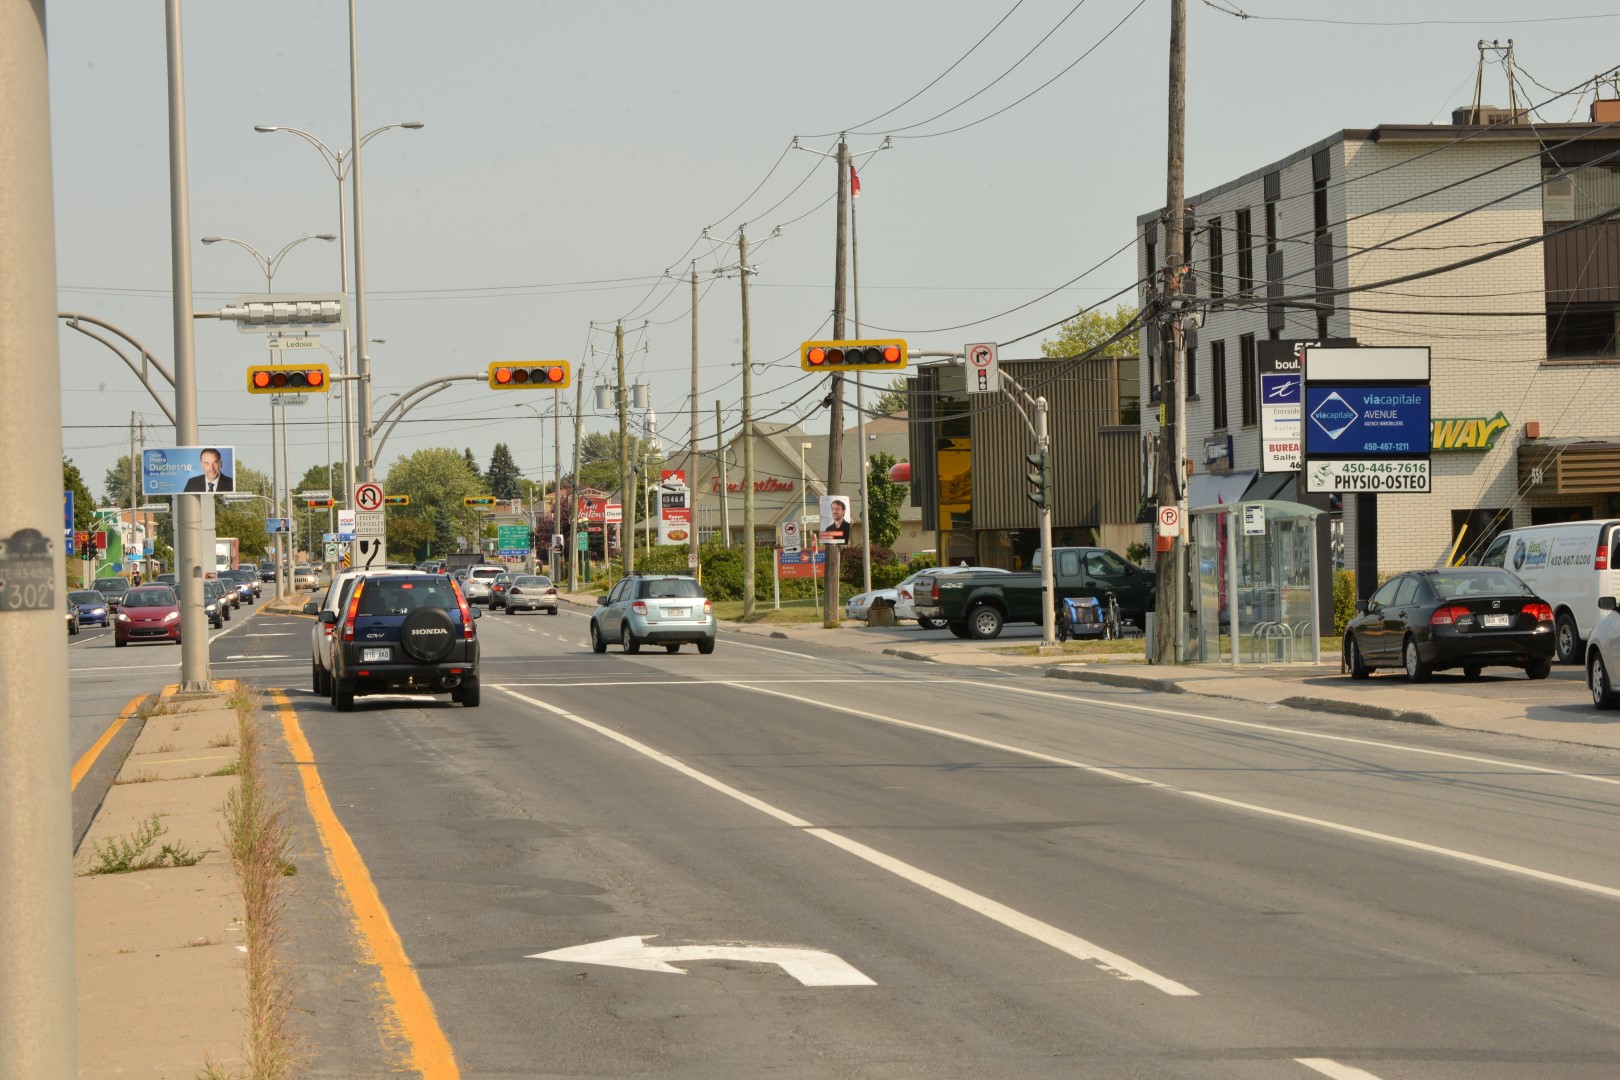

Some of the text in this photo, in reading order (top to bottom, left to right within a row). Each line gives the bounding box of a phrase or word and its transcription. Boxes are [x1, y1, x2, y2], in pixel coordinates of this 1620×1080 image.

[1275, 360, 1300, 369] boul.
[1363, 394, 1422, 406] viacapitale
[1315, 411, 1354, 420] viacapitale
[1363, 410, 1398, 419] AVENUE
[1431, 417, 1507, 449] WAY
[1269, 444, 1301, 452] BUREA
[1363, 442, 1409, 451] 450-467-1211
[149, 463, 193, 471] Duchesne
[1342, 463, 1426, 473] 450-446-7616
[1531, 467, 1543, 484] 551
[1334, 473, 1426, 489] PHYSIO-OSTÉO
[1551, 554, 1592, 566] 450.467.0206
[9, 583, 48, 609] 302
[411, 628, 448, 636] HONDA
